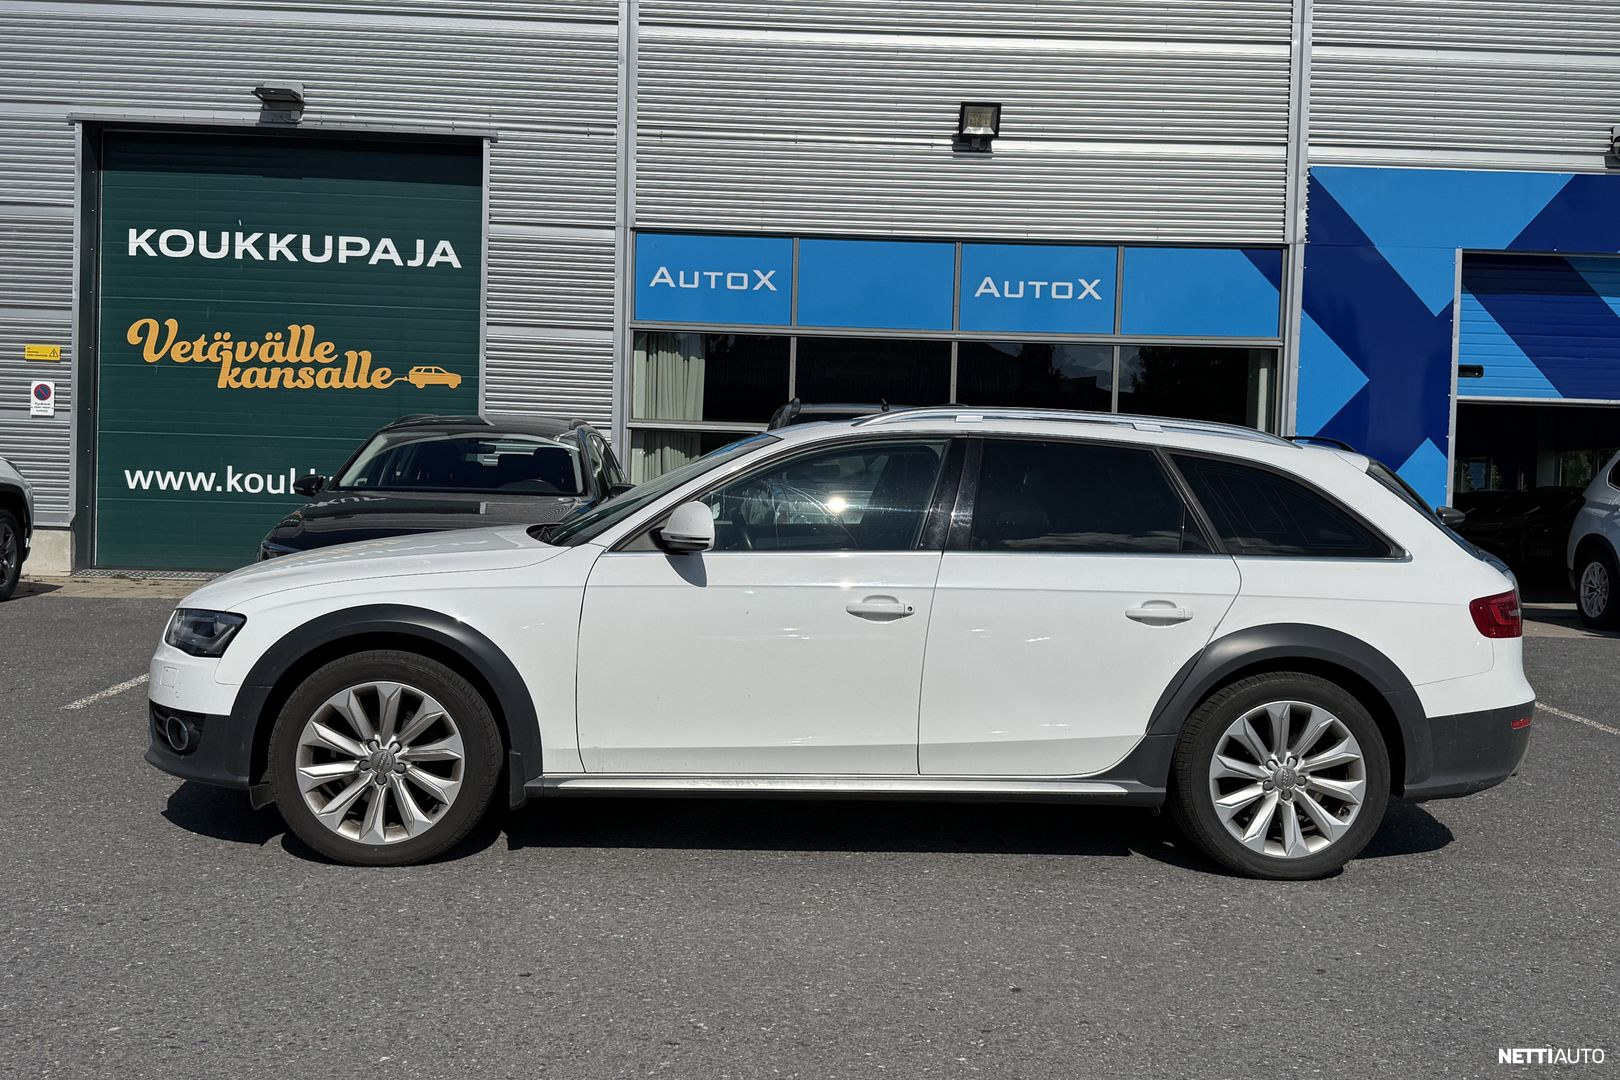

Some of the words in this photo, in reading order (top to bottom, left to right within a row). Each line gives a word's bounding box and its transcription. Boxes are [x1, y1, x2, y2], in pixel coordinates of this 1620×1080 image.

[128, 228, 462, 269] KOUKKUPAJA
[127, 318, 338, 363] Vetävälle
[217, 350, 393, 389] kansalle
